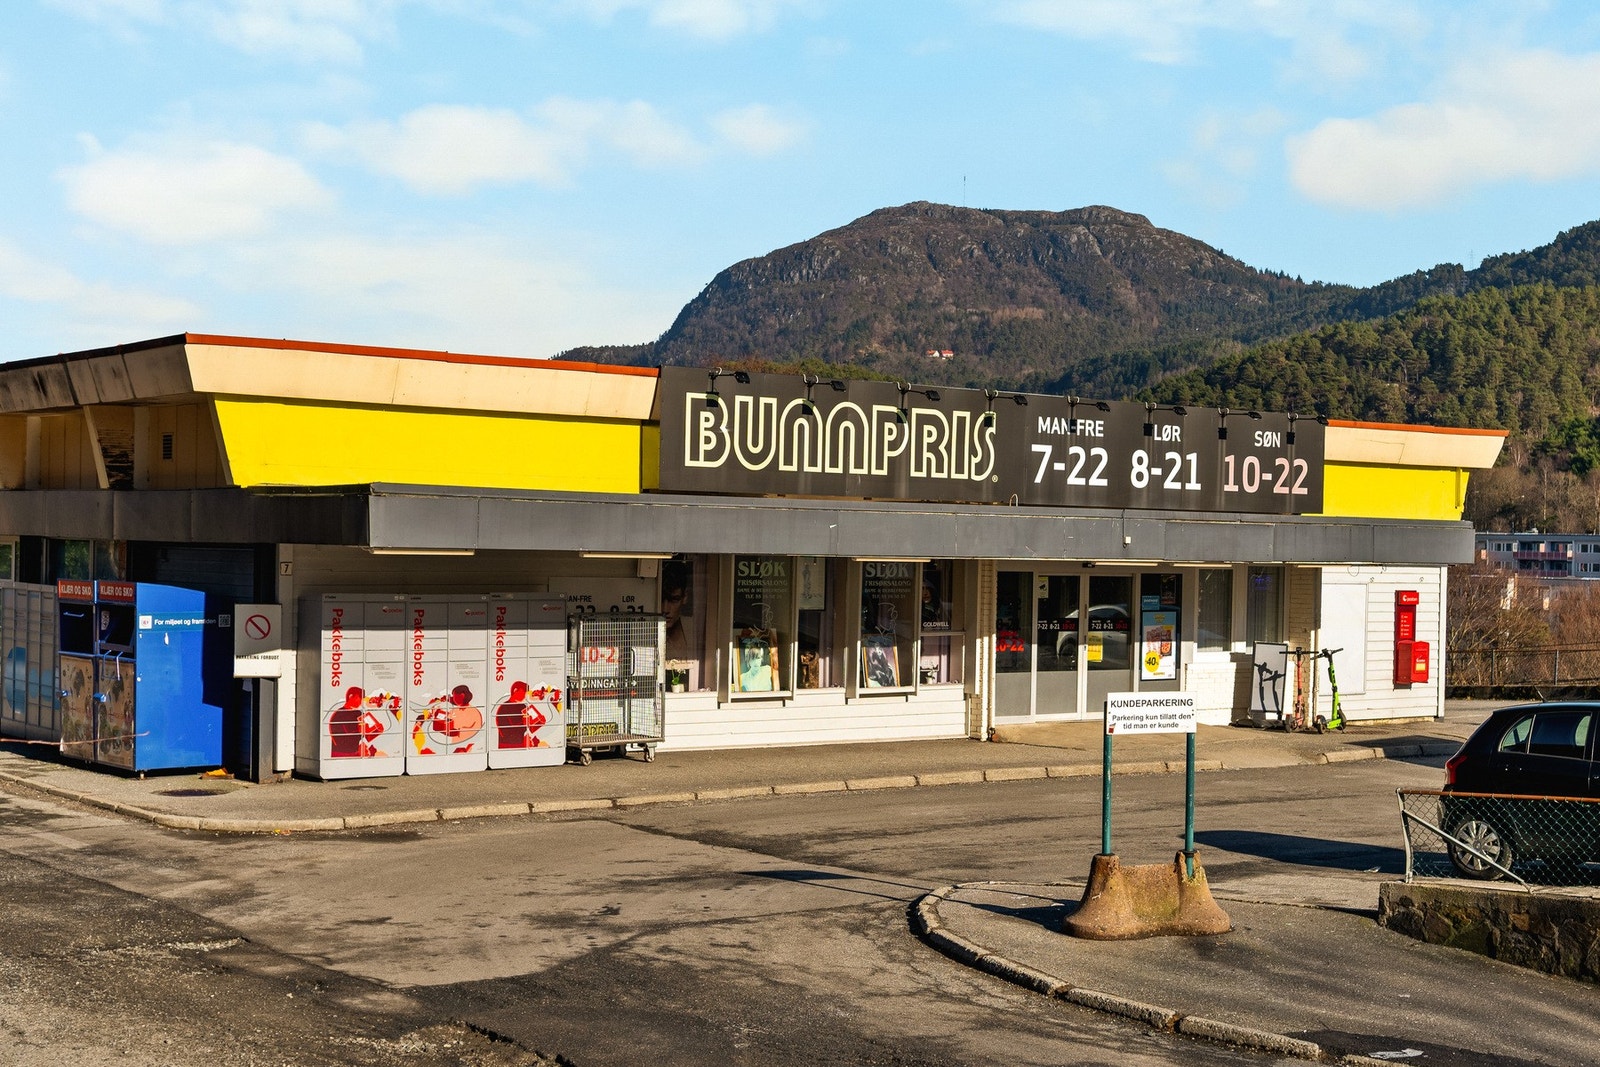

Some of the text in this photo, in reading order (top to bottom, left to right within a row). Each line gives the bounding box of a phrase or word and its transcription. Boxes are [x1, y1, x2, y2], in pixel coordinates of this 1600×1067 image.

[684, 391, 996, 482] BUNNPRIS
[1038, 416, 1281, 448] MAN-FRE LØR SØN
[1031, 444, 1308, 495] 7-22 8-21 10-22
[284, 564, 290, 574] 7
[737, 560, 786, 578] SLØK
[864, 562, 910, 579] SLØK
[74, 585, 81, 595] OG
[81, 586, 92, 596] SKO
[115, 586, 123, 596] OG
[123, 587, 134, 598] SKO
[568, 595, 635, 603] AN-FRE LØR
[331, 608, 343, 687] Pakkeboks
[414, 609, 425, 686] Pakkeboks
[496, 606, 506, 681] Pakkeboks
[1110, 698, 1194, 708] KUNDEPARKERING
[1112, 714, 1144, 722] Parkering
